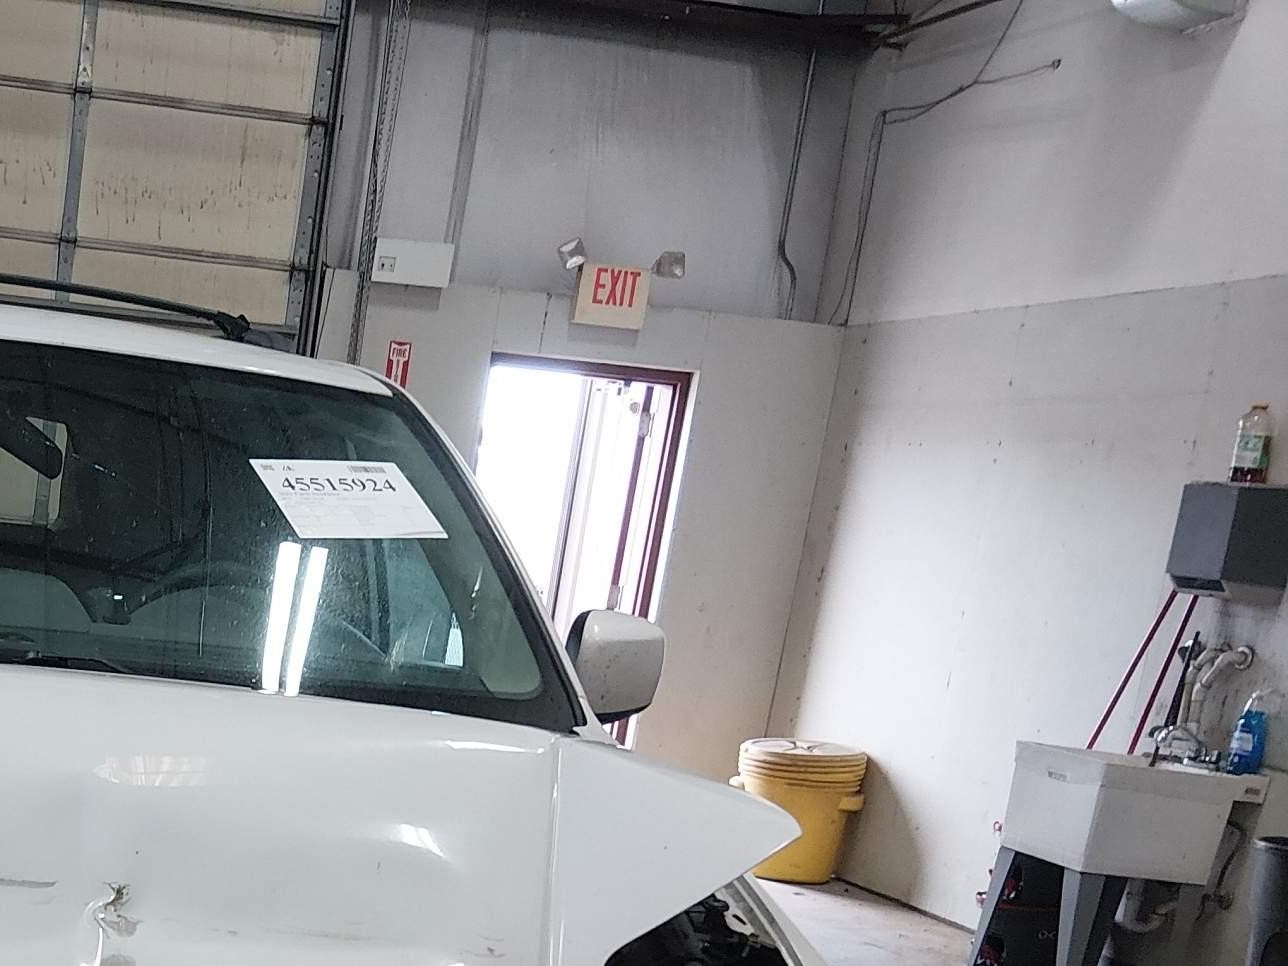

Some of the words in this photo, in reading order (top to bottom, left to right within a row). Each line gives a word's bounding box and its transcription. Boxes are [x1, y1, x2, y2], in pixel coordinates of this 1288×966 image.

[592, 268, 641, 307] EXIT
[392, 347, 407, 358] FIRE
[282, 477, 396, 492] 45515924
